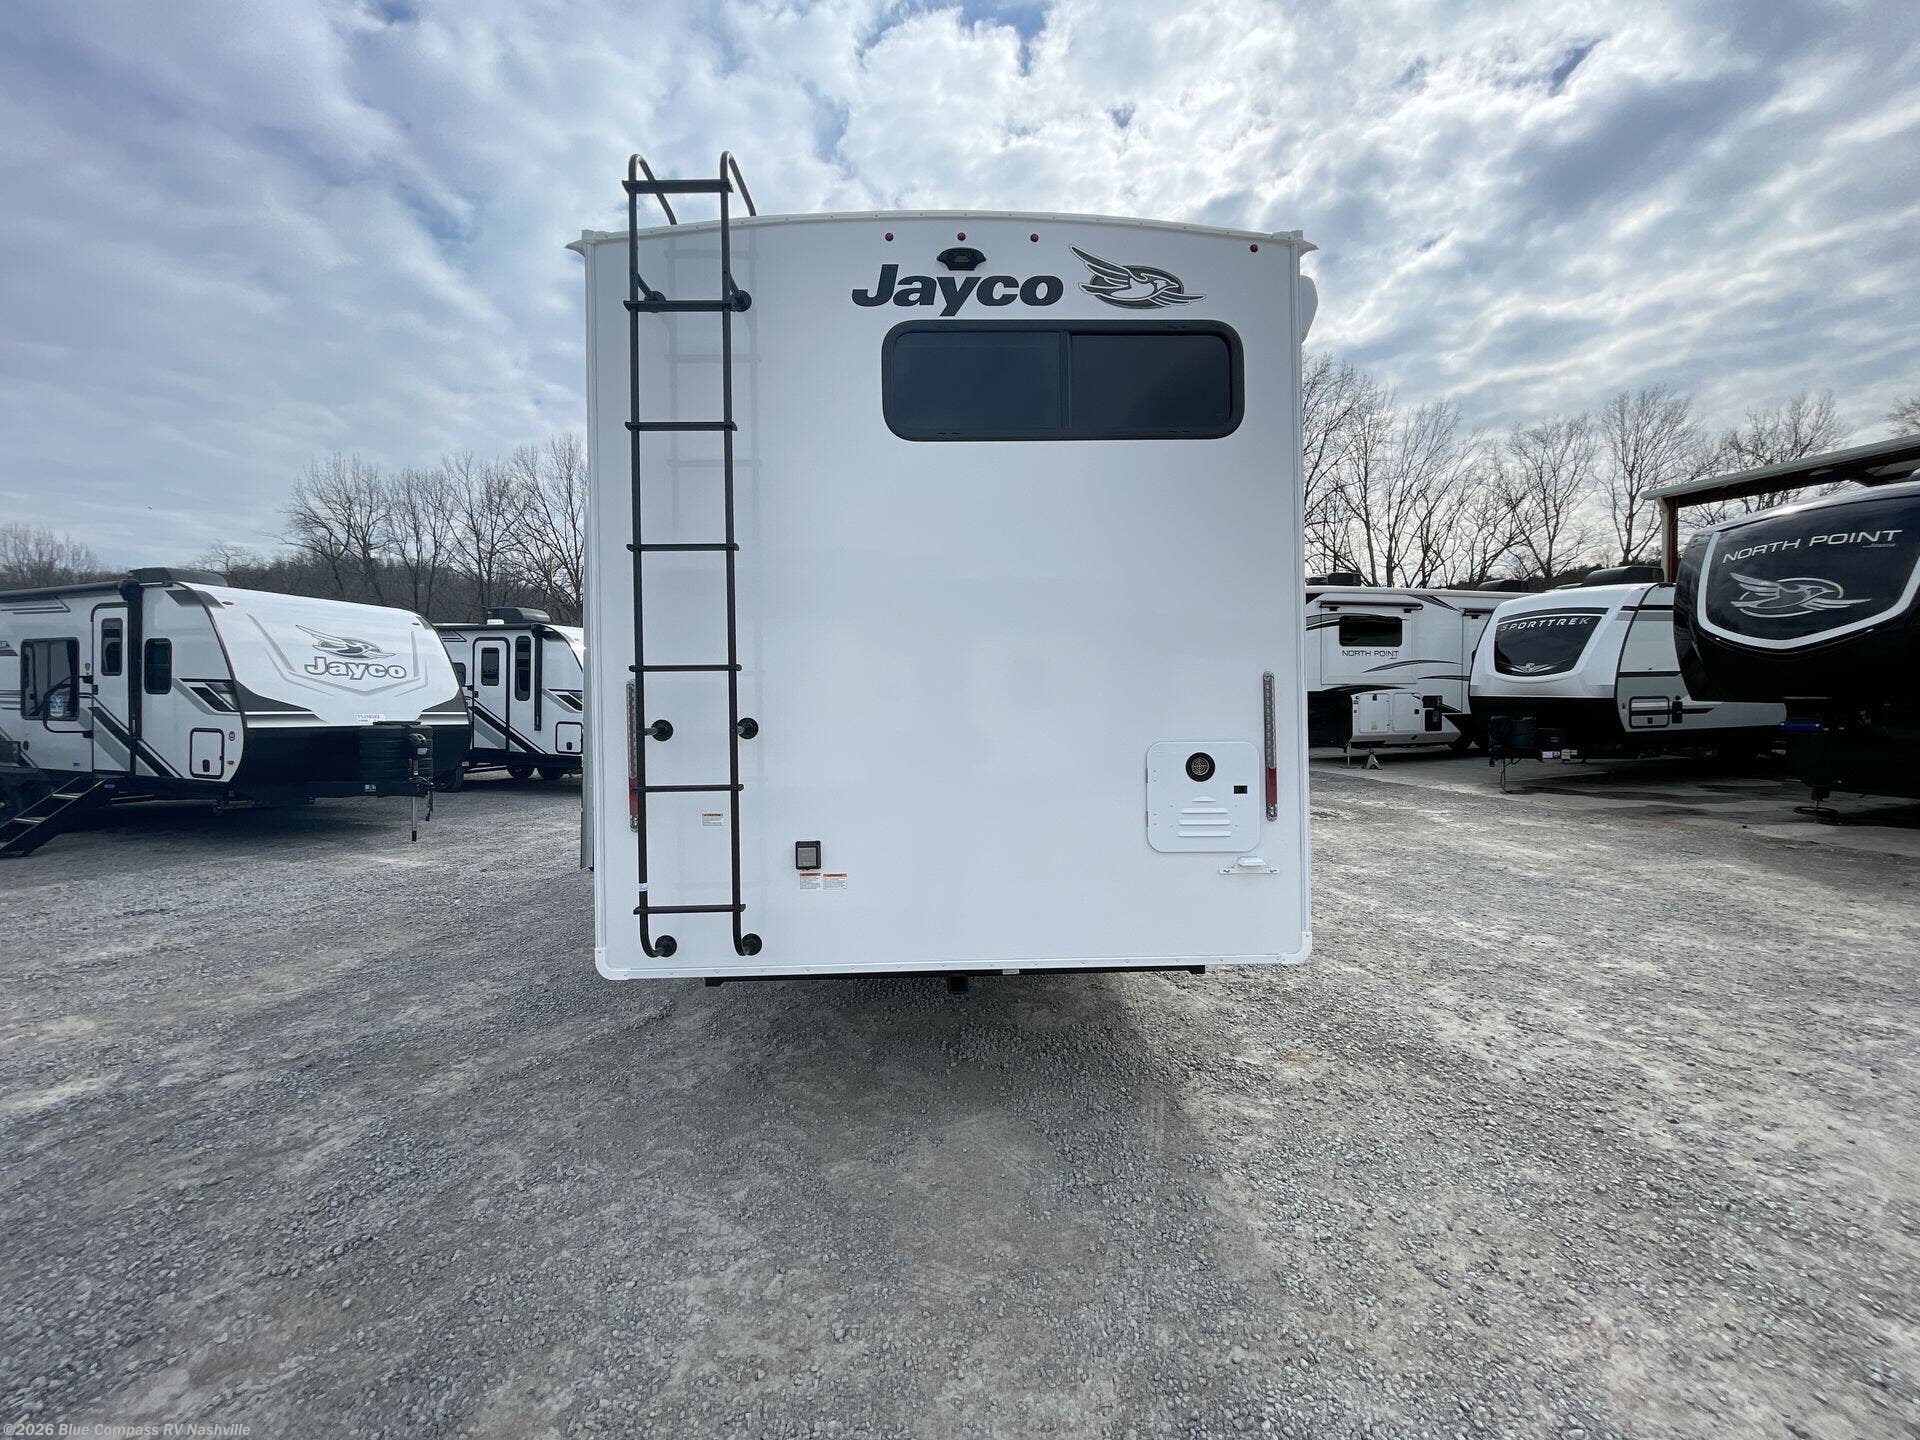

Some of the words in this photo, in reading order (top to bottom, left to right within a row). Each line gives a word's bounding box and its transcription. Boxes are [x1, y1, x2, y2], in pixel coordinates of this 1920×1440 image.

[851, 263, 1064, 317] Jayco
[1722, 538, 1801, 564] NORTH
[1808, 529, 1903, 547] POINT
[1500, 617, 1592, 632] SPORTTREK
[304, 656, 407, 680] Jayco
